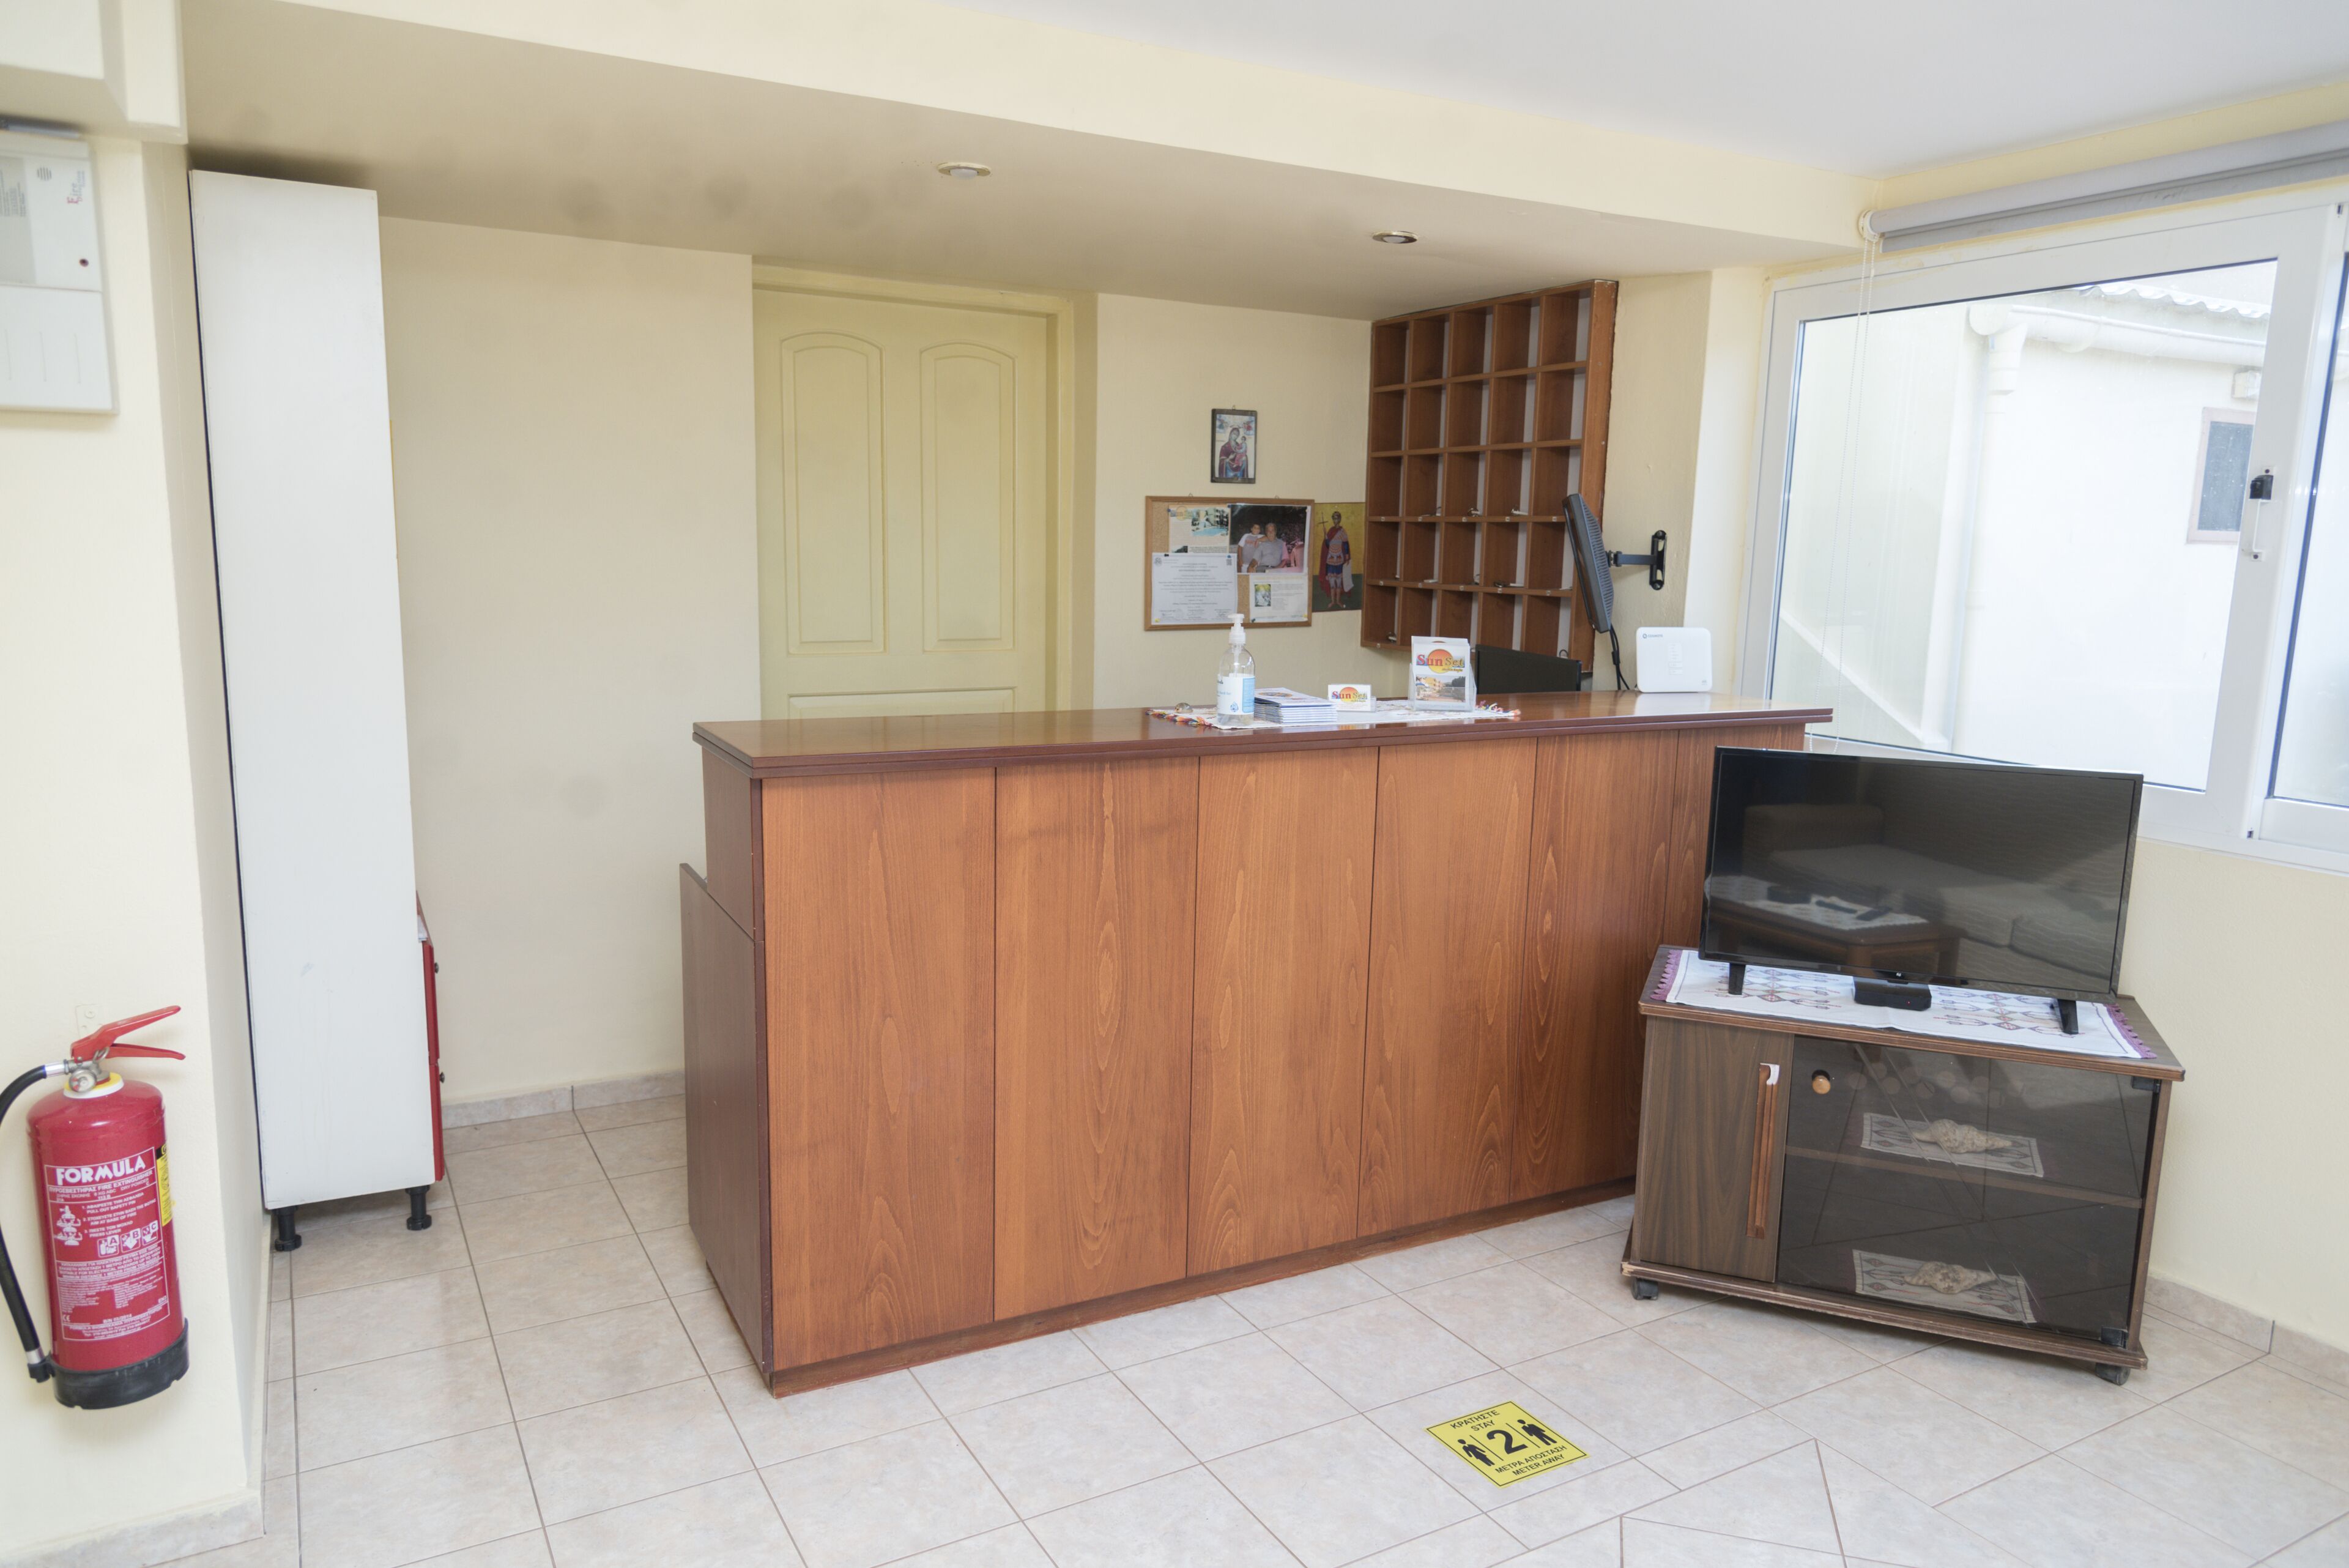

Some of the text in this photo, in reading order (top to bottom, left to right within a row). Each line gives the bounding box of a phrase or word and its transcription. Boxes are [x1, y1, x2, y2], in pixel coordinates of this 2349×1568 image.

[1416, 654, 1464, 667] Sun Set
[1332, 691, 1351, 699] Sun
[56, 1155, 146, 1186] FORMULA
[113, 1170, 152, 1187] EXTINGUISHER
[110, 1237, 117, 1246] A
[133, 1230, 139, 1239] B
[1450, 1410, 1501, 1429] ΚΡΑΤΗΣΤΕ
[1471, 1420, 1495, 1431] STAY
[1486, 1429, 1529, 1455] 2
[1494, 1445, 1567, 1473] ΜΕΤΡΑ ΑΠΟΣΤΑΣΗ
[1512, 1454, 1564, 1476] METER AWAY
